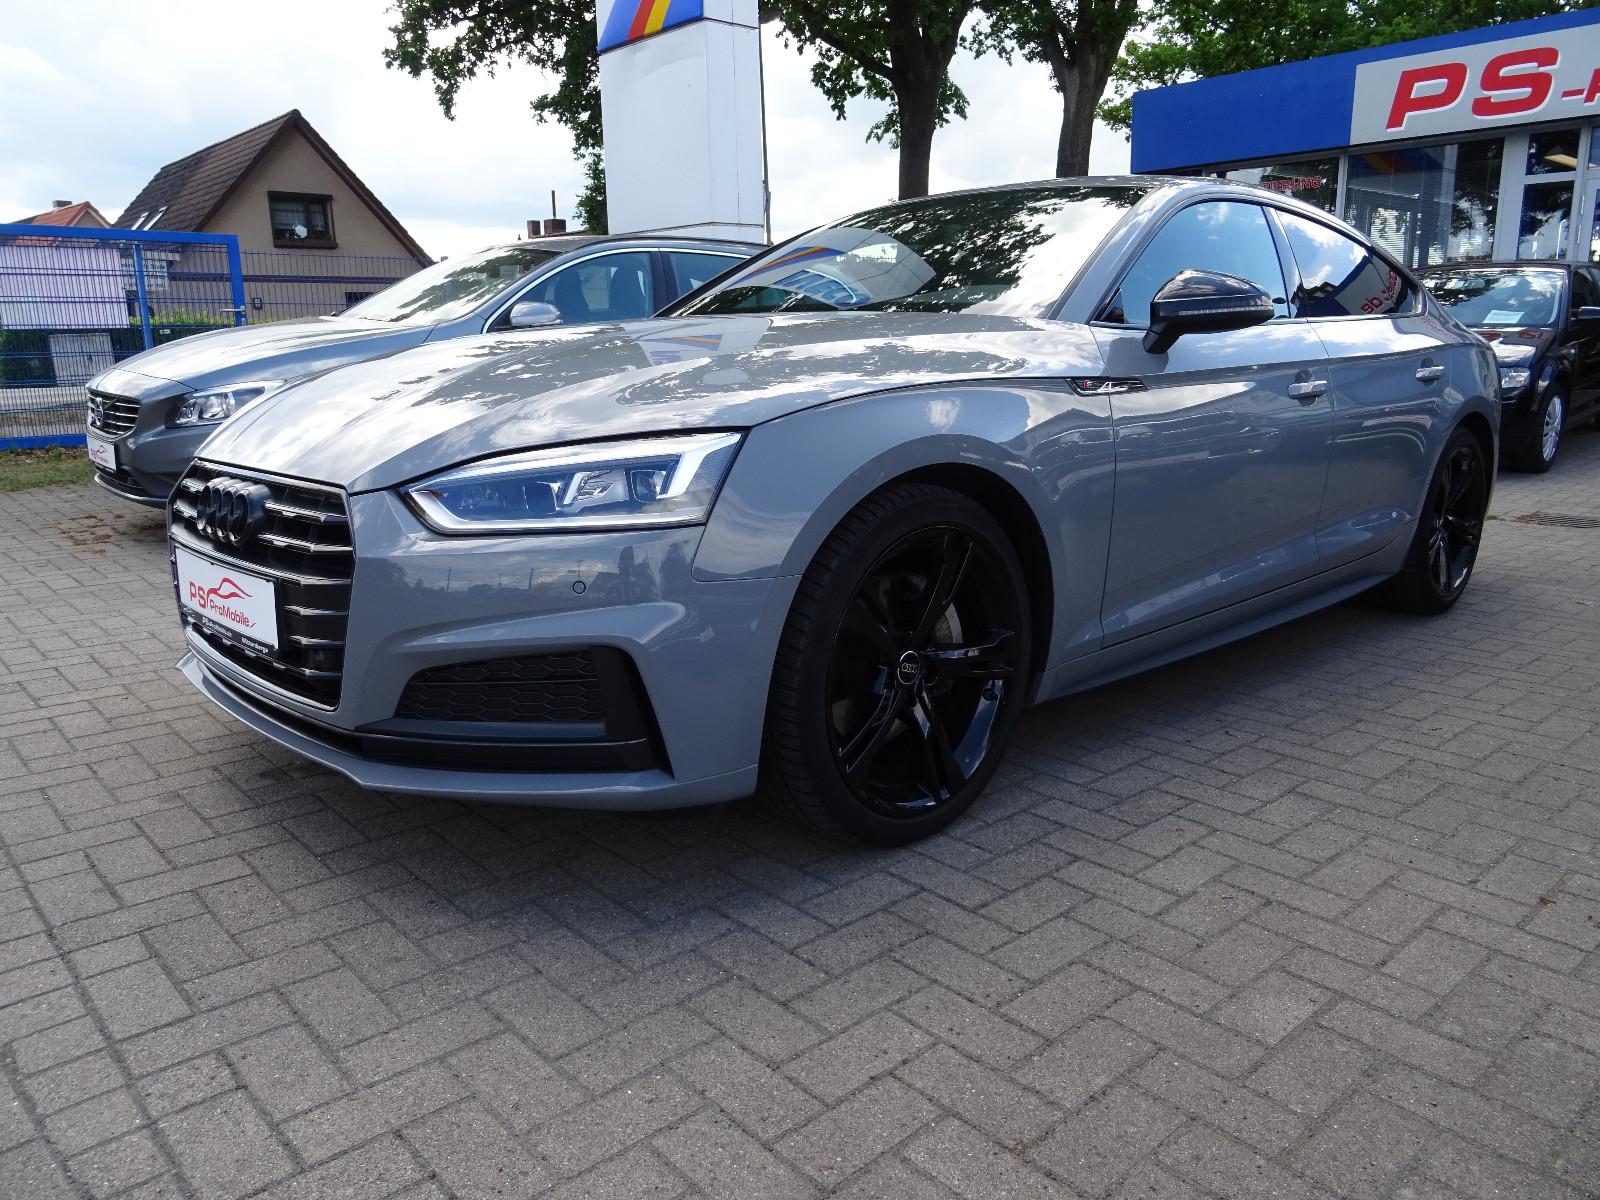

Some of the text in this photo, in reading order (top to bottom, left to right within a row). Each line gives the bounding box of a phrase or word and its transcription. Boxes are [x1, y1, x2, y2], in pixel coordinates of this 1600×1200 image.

[1385, 47, 1600, 132] PS-
[189, 580, 207, 609] PS
[209, 599, 251, 628] ProMobile
